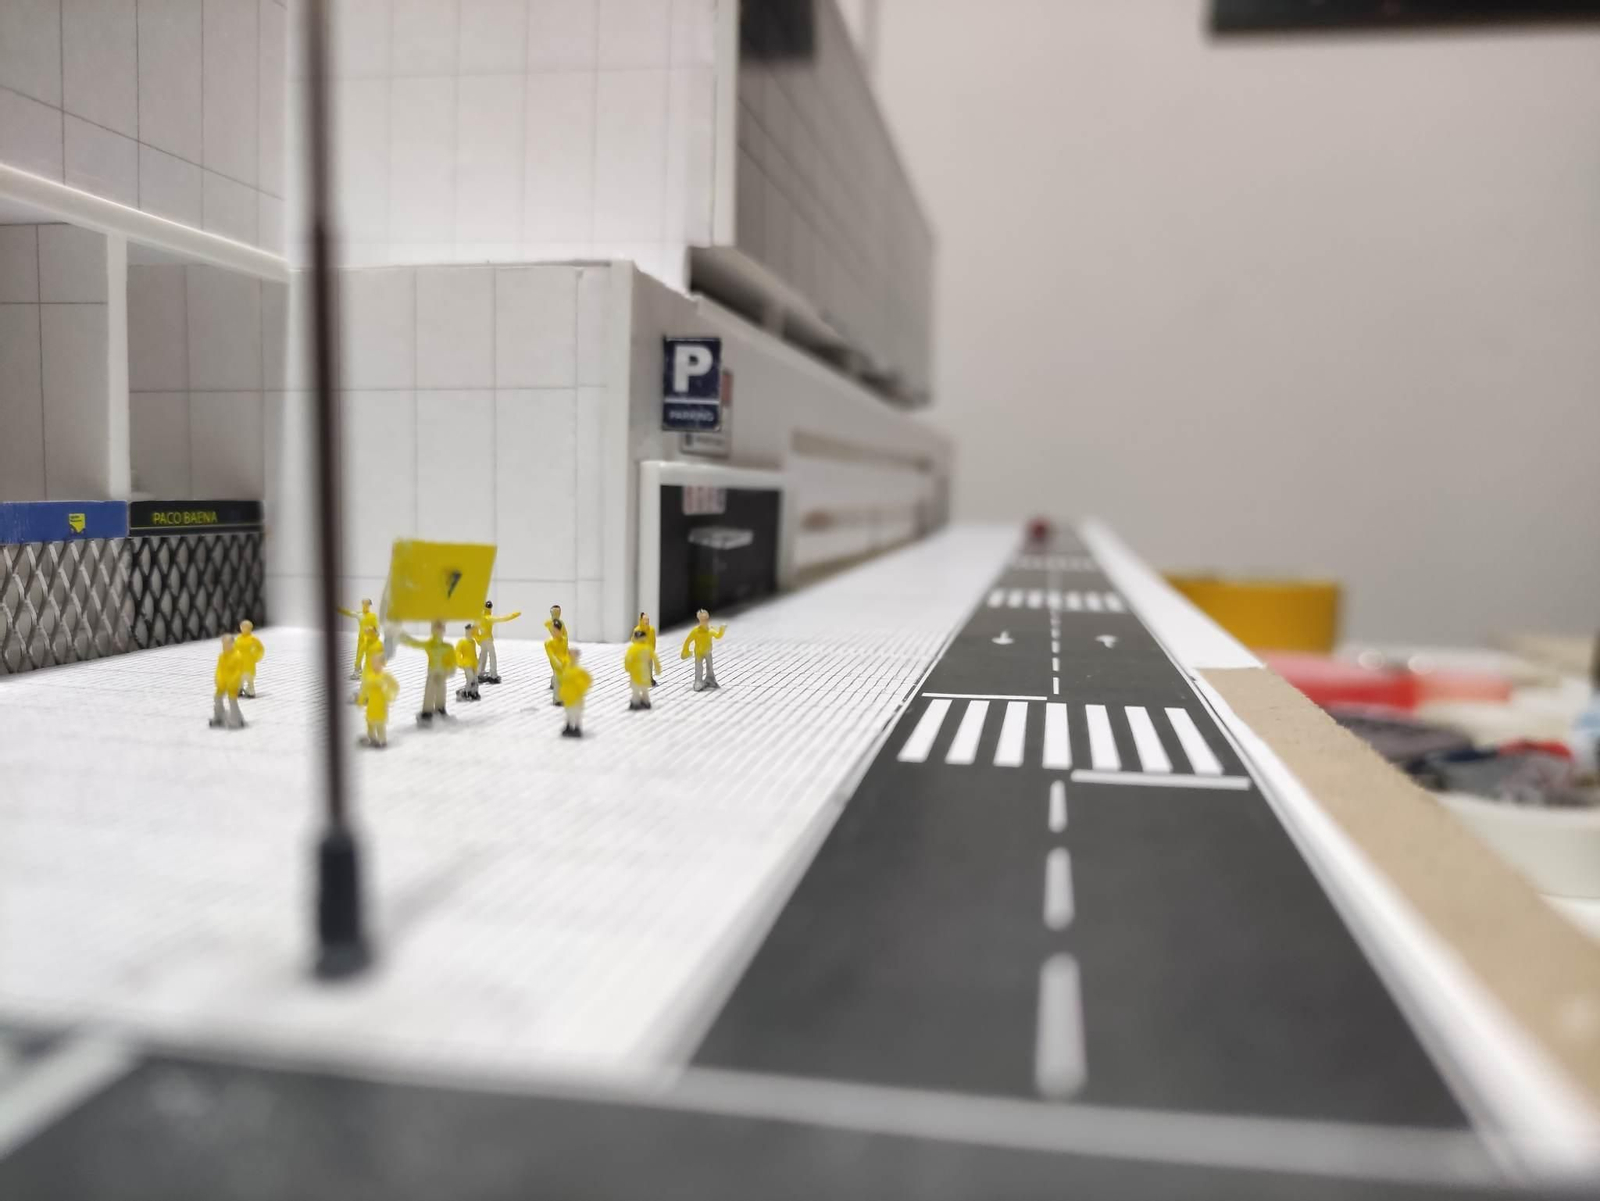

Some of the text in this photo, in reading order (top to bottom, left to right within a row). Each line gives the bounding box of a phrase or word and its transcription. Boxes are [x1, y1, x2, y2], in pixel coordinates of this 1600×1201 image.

[674, 345, 713, 393] P
[153, 511, 218, 525] PACO BAENA
